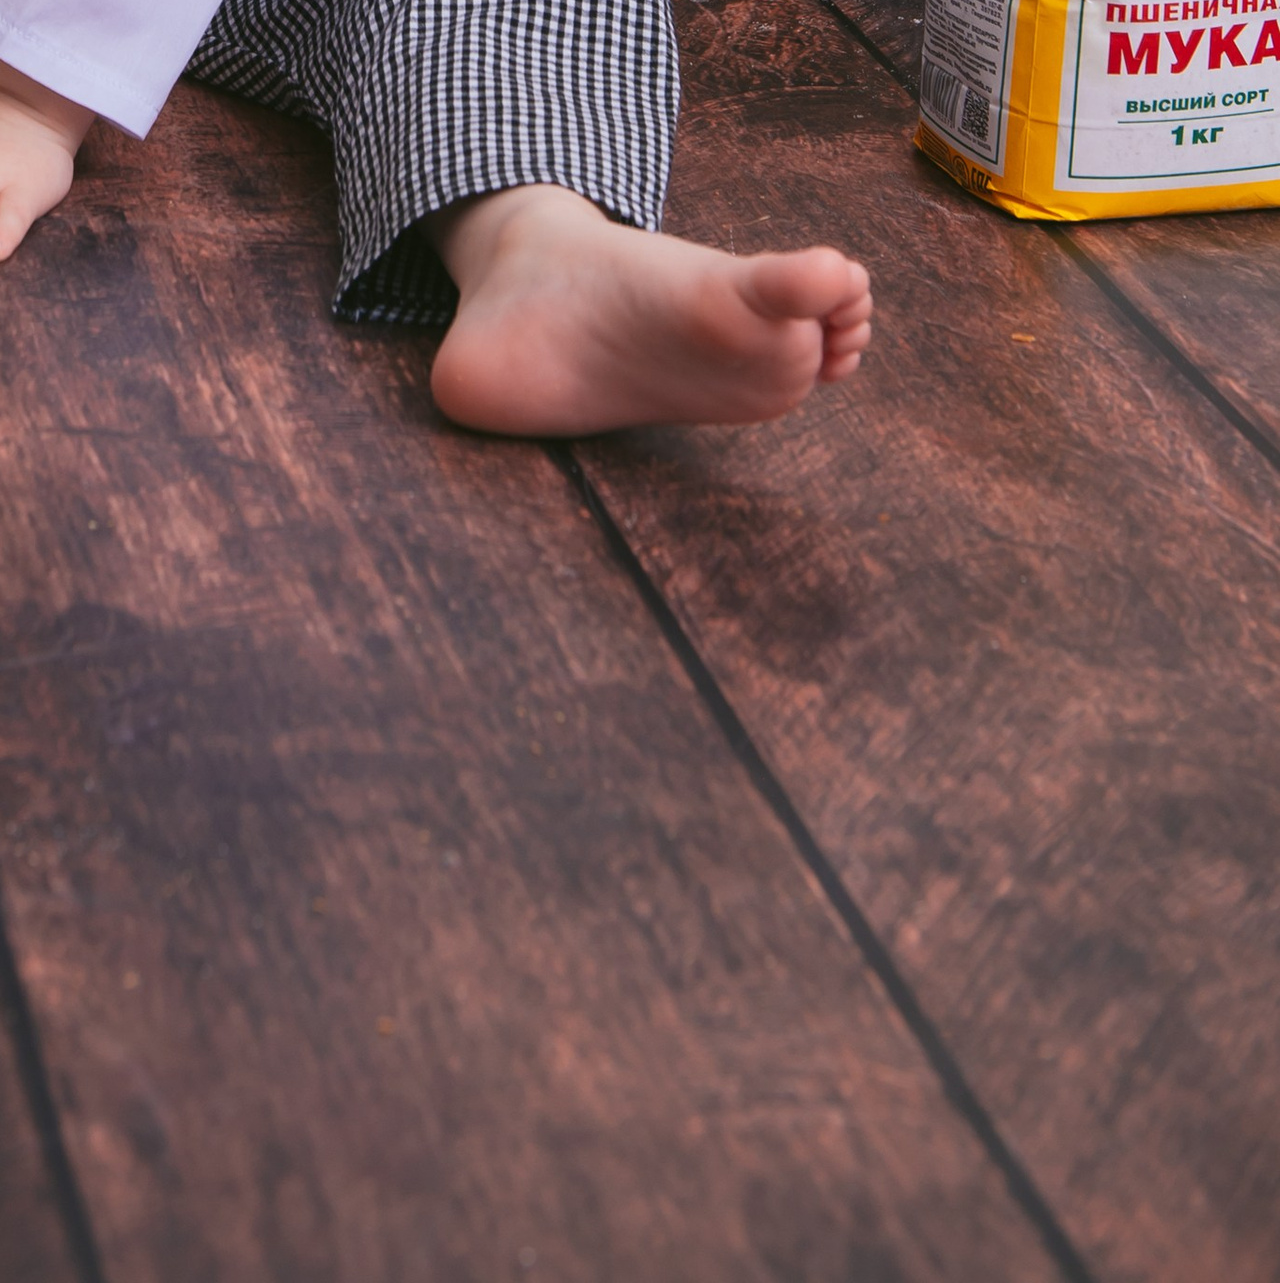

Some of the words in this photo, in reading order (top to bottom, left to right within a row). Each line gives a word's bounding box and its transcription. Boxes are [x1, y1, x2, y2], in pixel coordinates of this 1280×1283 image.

[1107, 19, 1280, 75] МУКА
[1126, 92, 1216, 113] ВЫСШИЙ
[1221, 88, 1269, 107] СОРТ
[1171, 125, 1185, 146] 1
